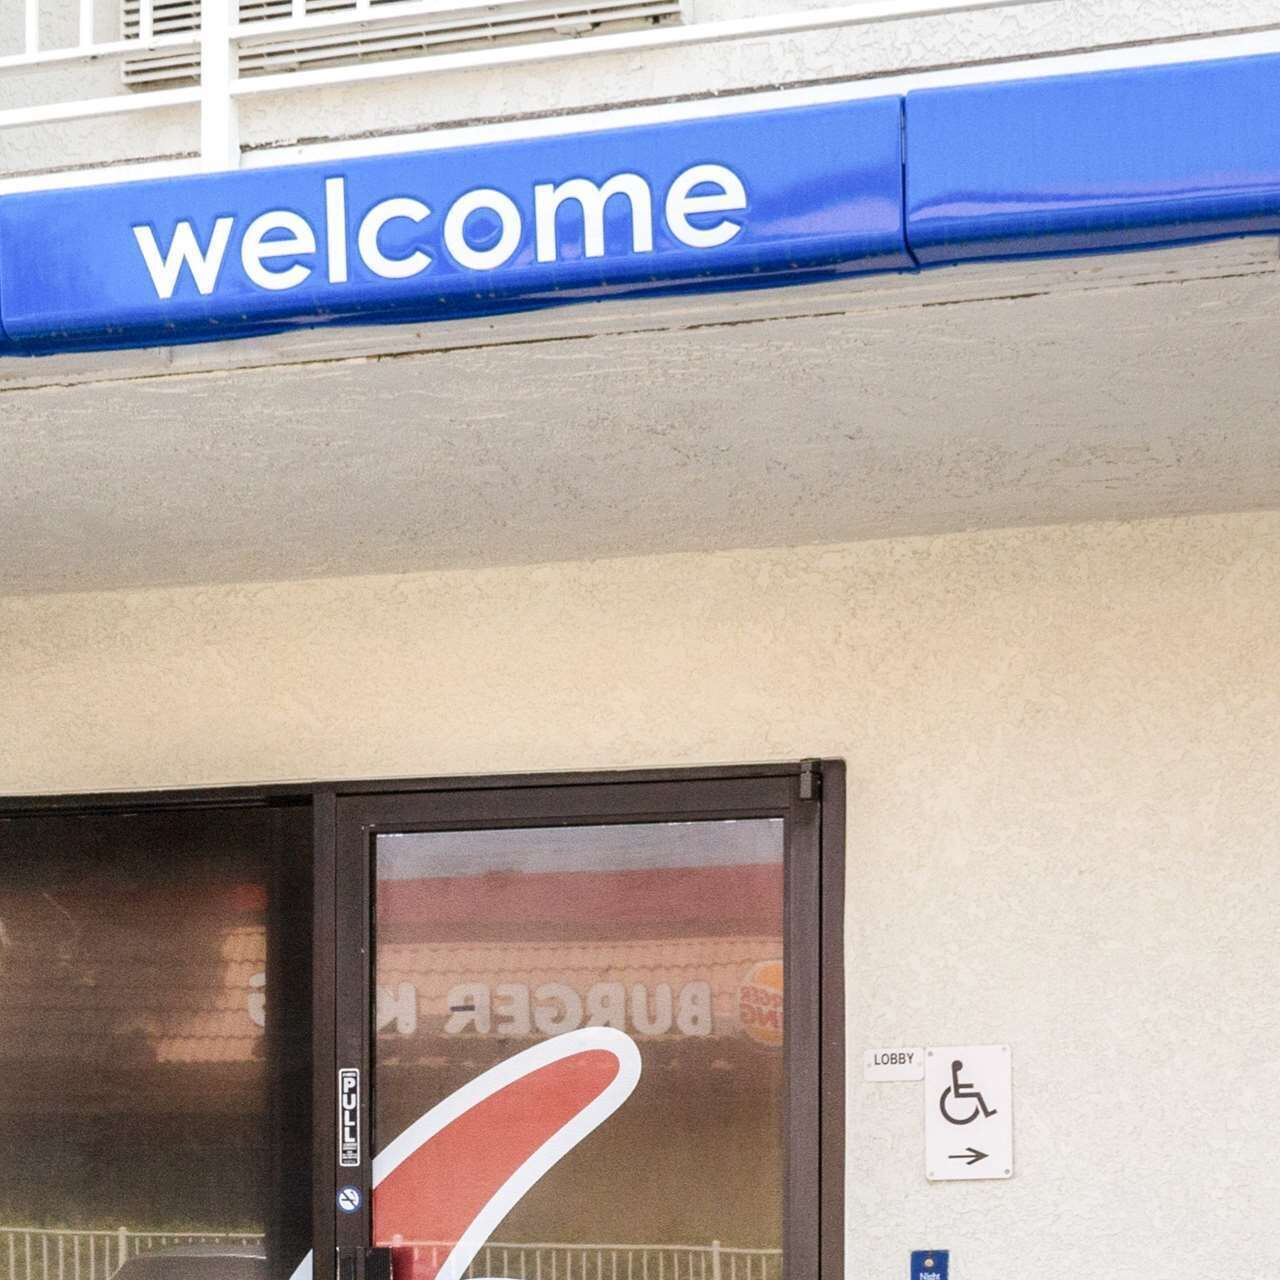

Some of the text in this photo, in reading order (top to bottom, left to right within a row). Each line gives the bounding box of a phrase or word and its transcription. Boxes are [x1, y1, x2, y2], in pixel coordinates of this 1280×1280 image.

[132, 163, 748, 299] welcome
[874, 1052, 914, 1066] LOBBY
[342, 1077, 356, 1143] PULL
